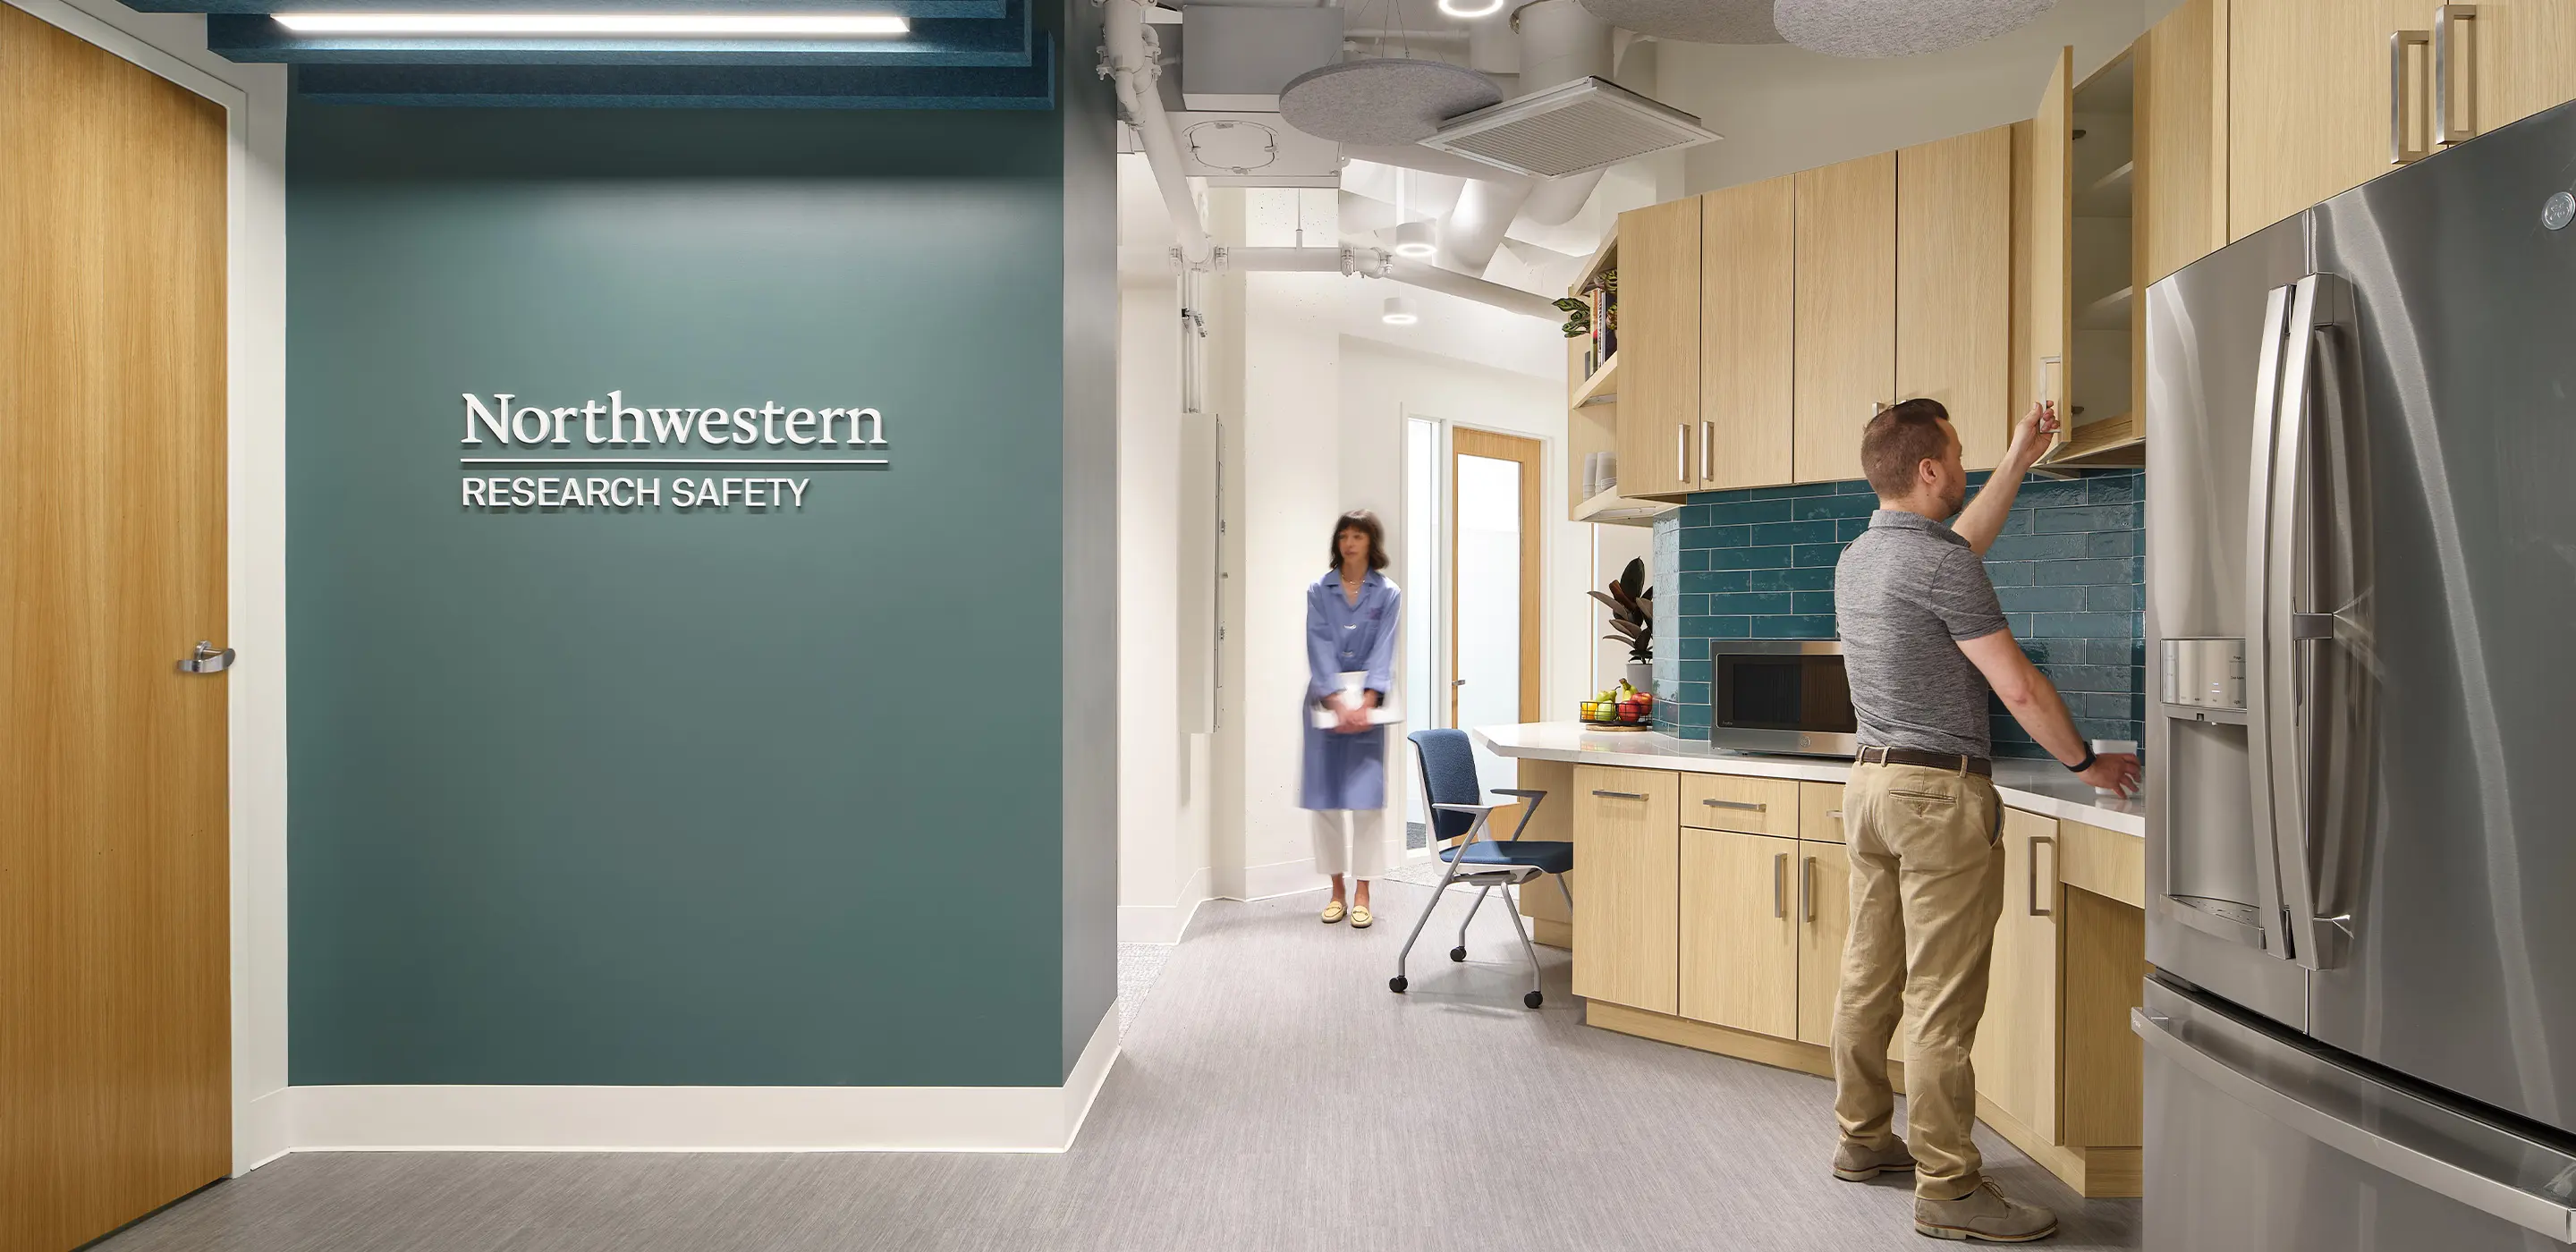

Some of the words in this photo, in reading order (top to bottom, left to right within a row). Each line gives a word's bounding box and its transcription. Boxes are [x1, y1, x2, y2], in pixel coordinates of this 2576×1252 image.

[461, 389, 888, 445] Northwestern
[462, 477, 660, 507] RESEARCH
[671, 477, 809, 507] SAFETY
